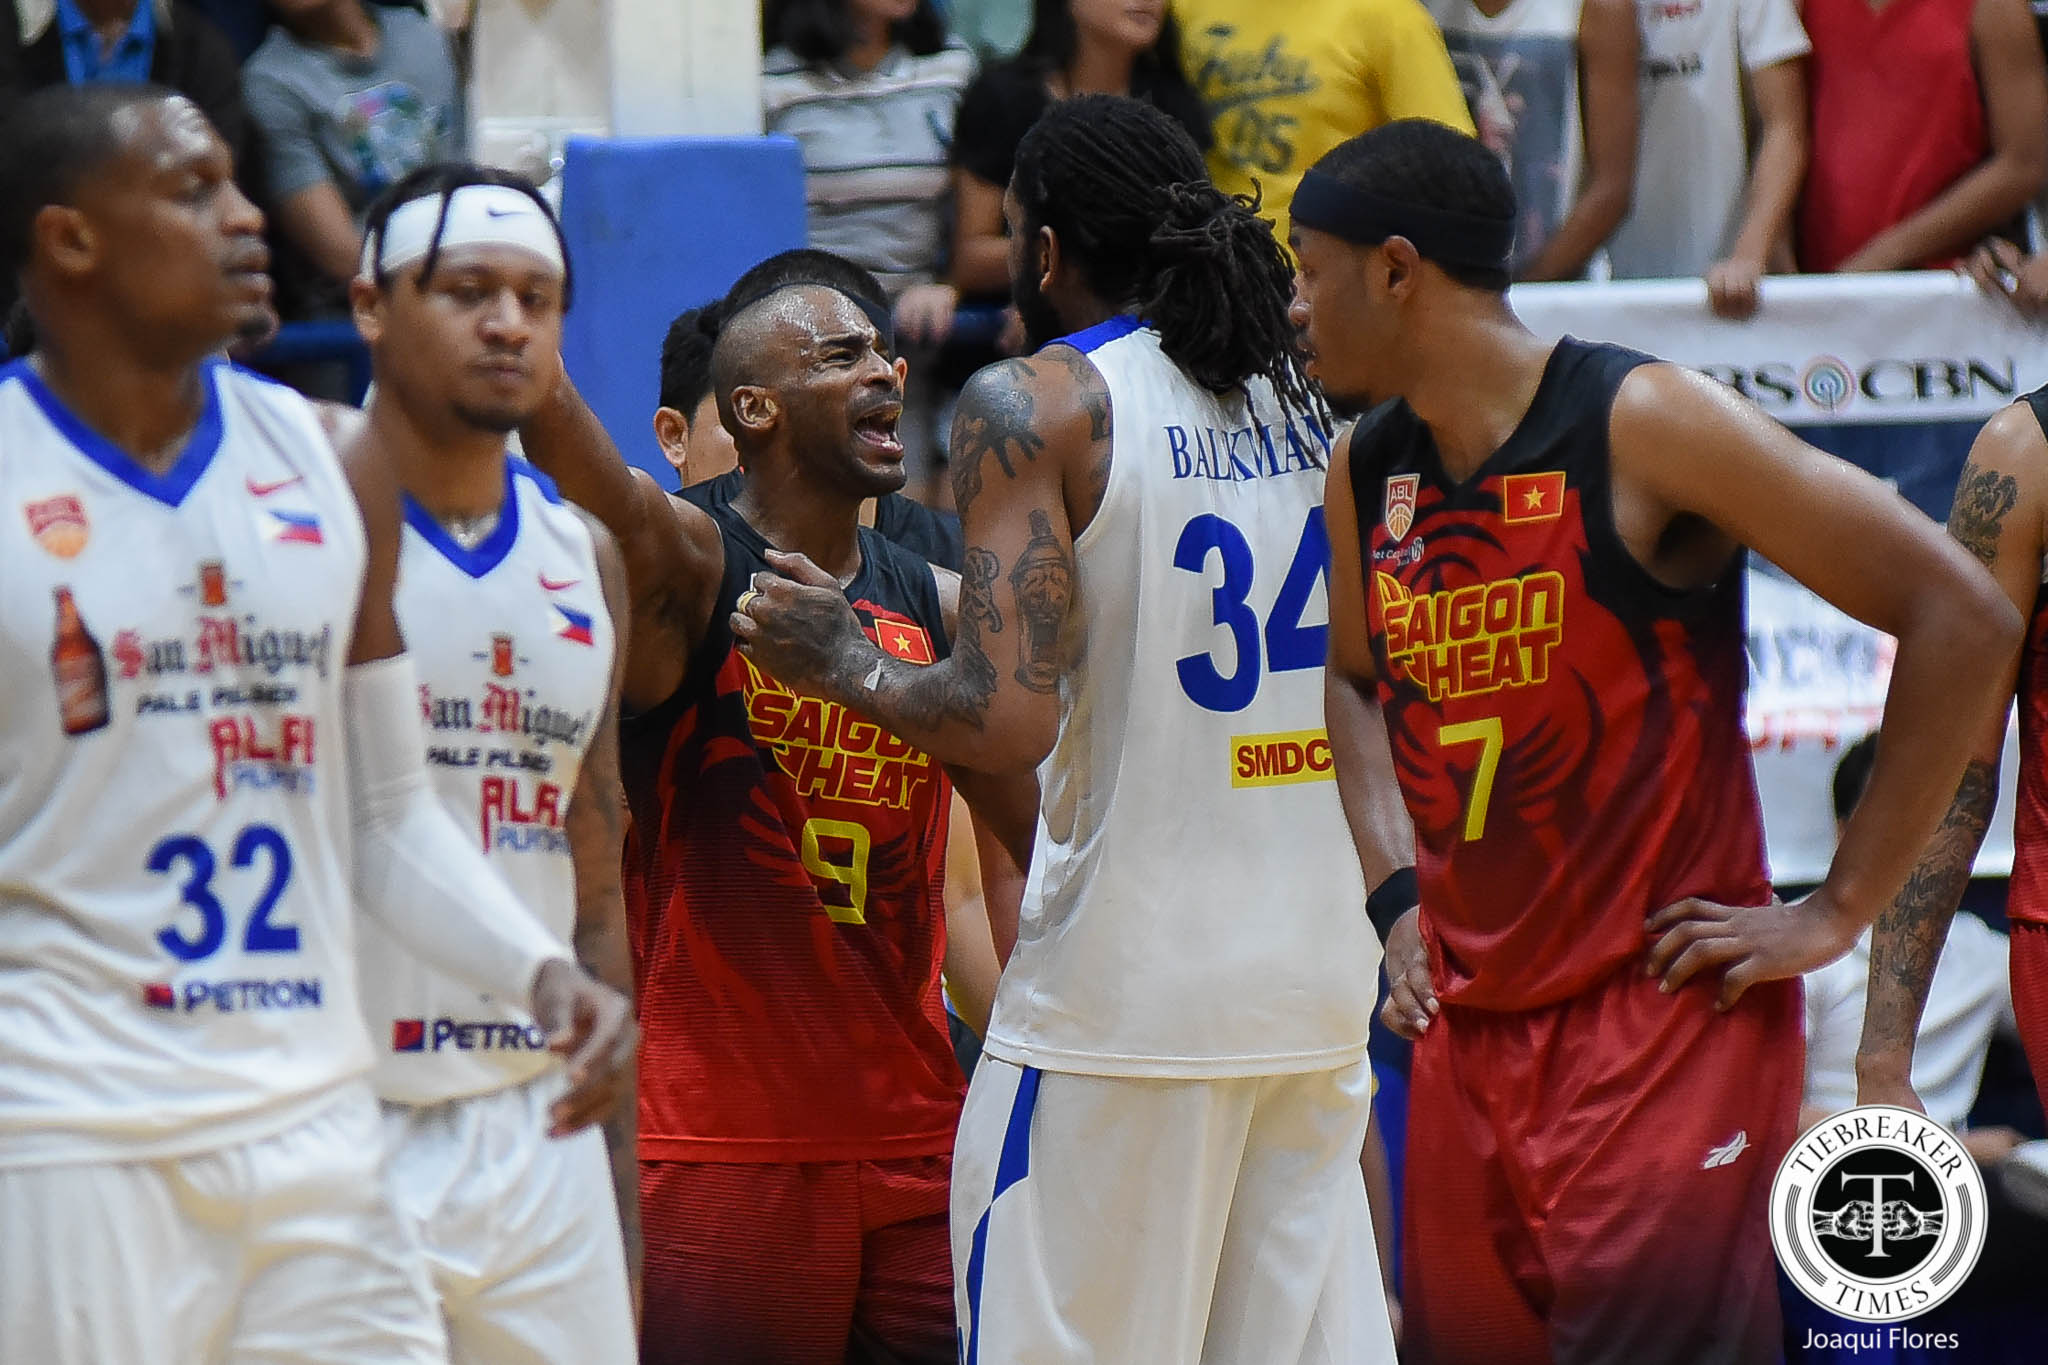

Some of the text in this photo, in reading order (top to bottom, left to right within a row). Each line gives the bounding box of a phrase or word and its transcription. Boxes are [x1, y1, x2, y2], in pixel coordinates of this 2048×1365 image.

[1859, 358, 2015, 400] CBN
[1164, 415, 1333, 484] BALKMAN
[1391, 485, 1413, 503] ABL
[1172, 504, 1332, 714] 34
[1384, 570, 1565, 656] SAIGON
[112, 628, 187, 681] San
[1412, 630, 1563, 700] HEAT
[785, 748, 929, 809] HEAT
[1236, 739, 1332, 779] SMDC
[1439, 716, 1504, 842] 7
[145, 822, 300, 961] 32
[801, 818, 871, 925] 9
[183, 977, 322, 1014] PETRON
